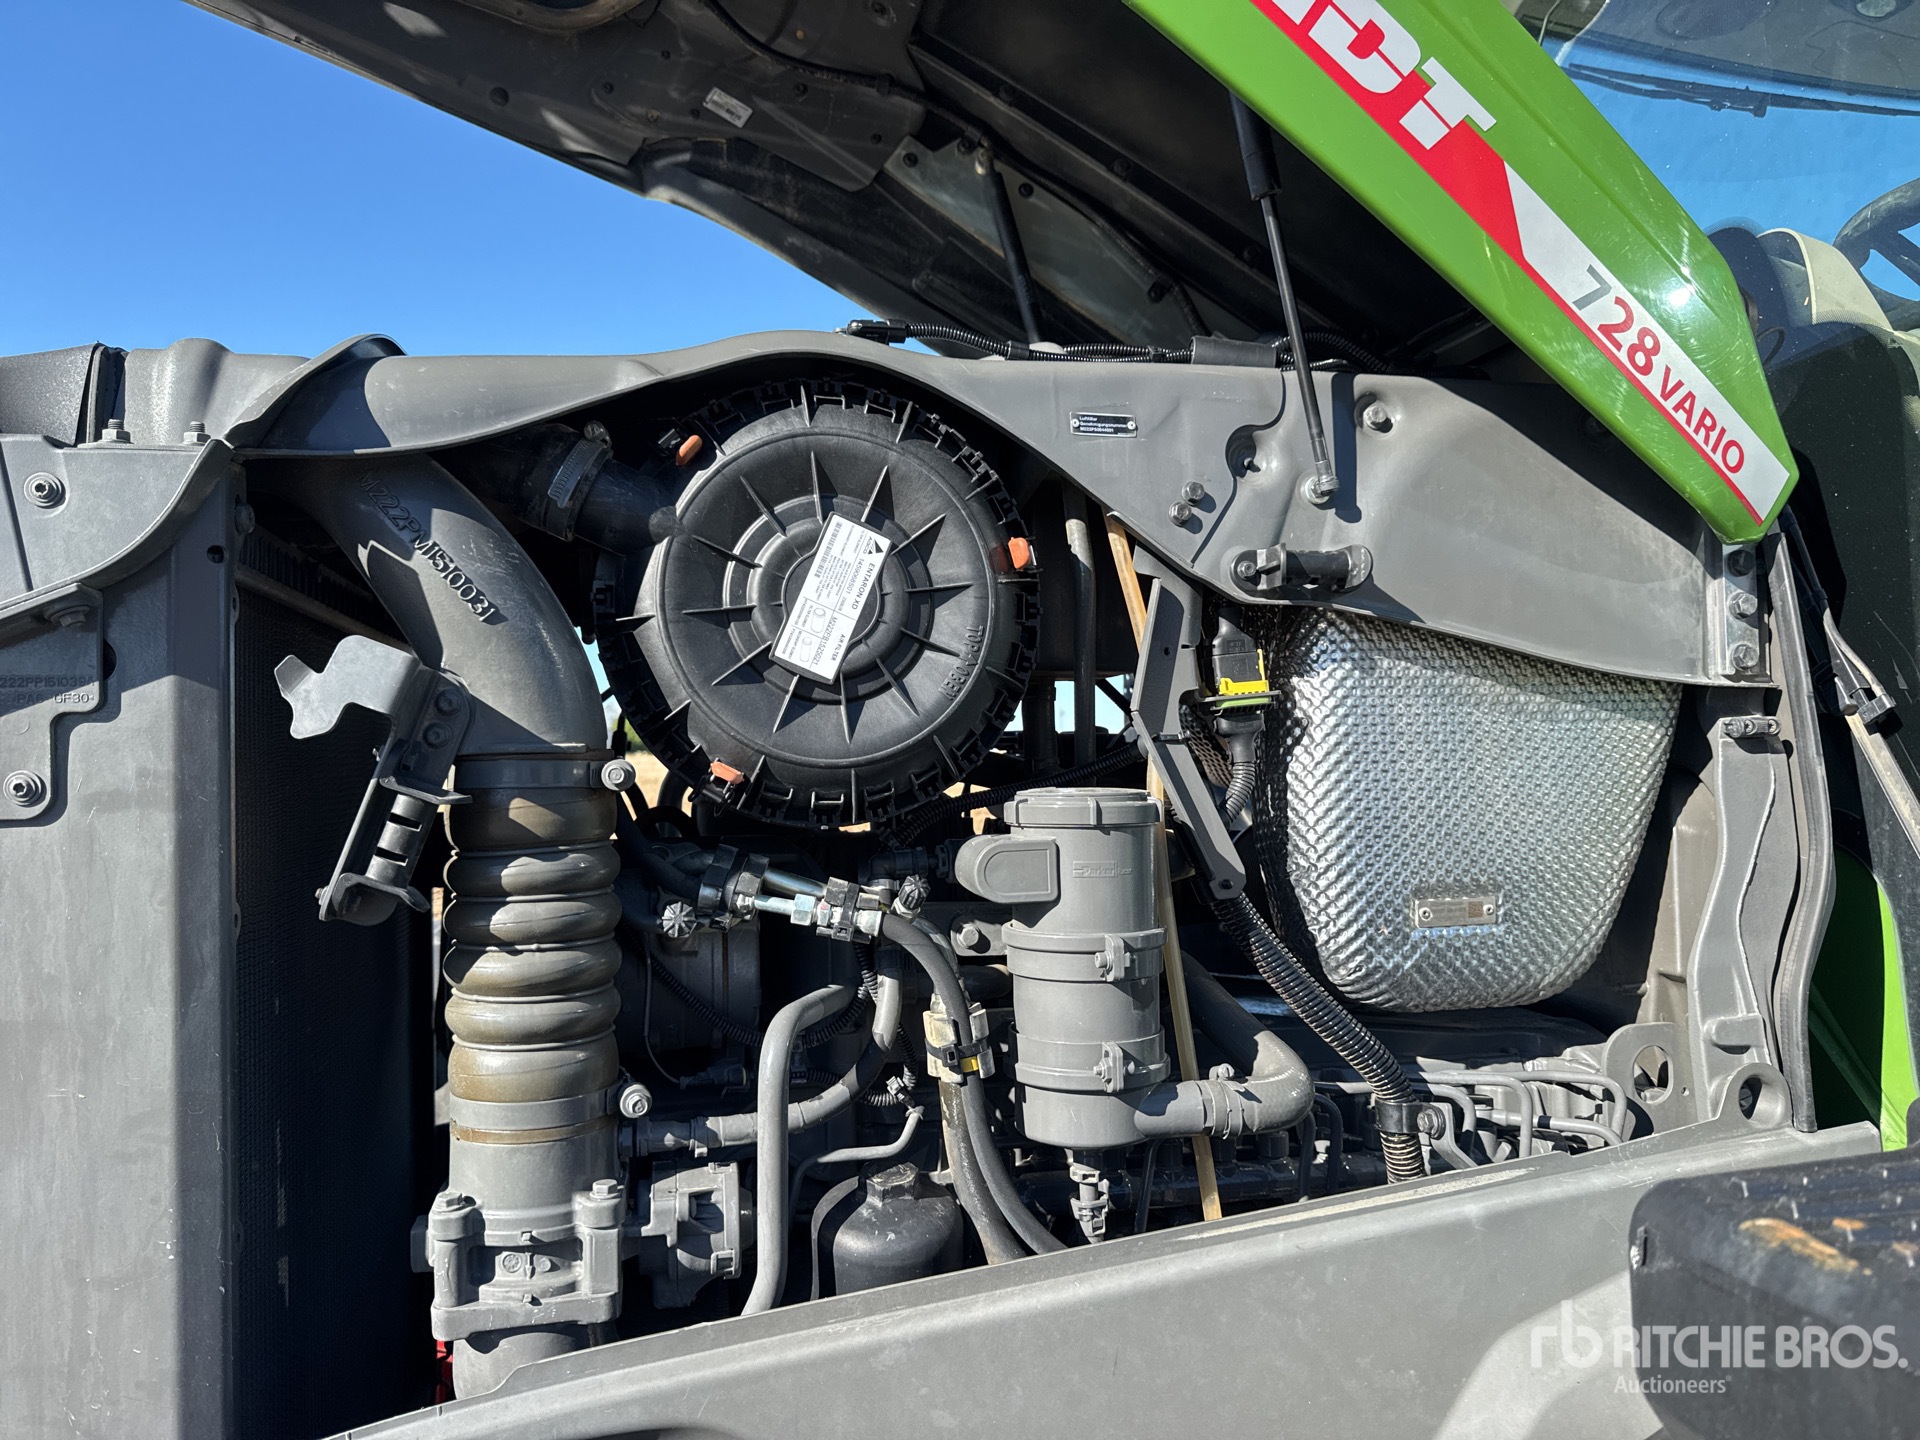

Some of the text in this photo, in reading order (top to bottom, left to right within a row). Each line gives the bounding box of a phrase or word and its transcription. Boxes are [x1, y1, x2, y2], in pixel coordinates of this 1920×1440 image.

[1271, 0, 1497, 150] DT
[1572, 264, 1745, 474] 728 VARIO
[356, 471, 496, 622] M222PM1510031
[851, 563, 874, 609] ENTARON XD
[830, 643, 841, 661] FILTER
[938, 625, 984, 700] TOP OBEN
